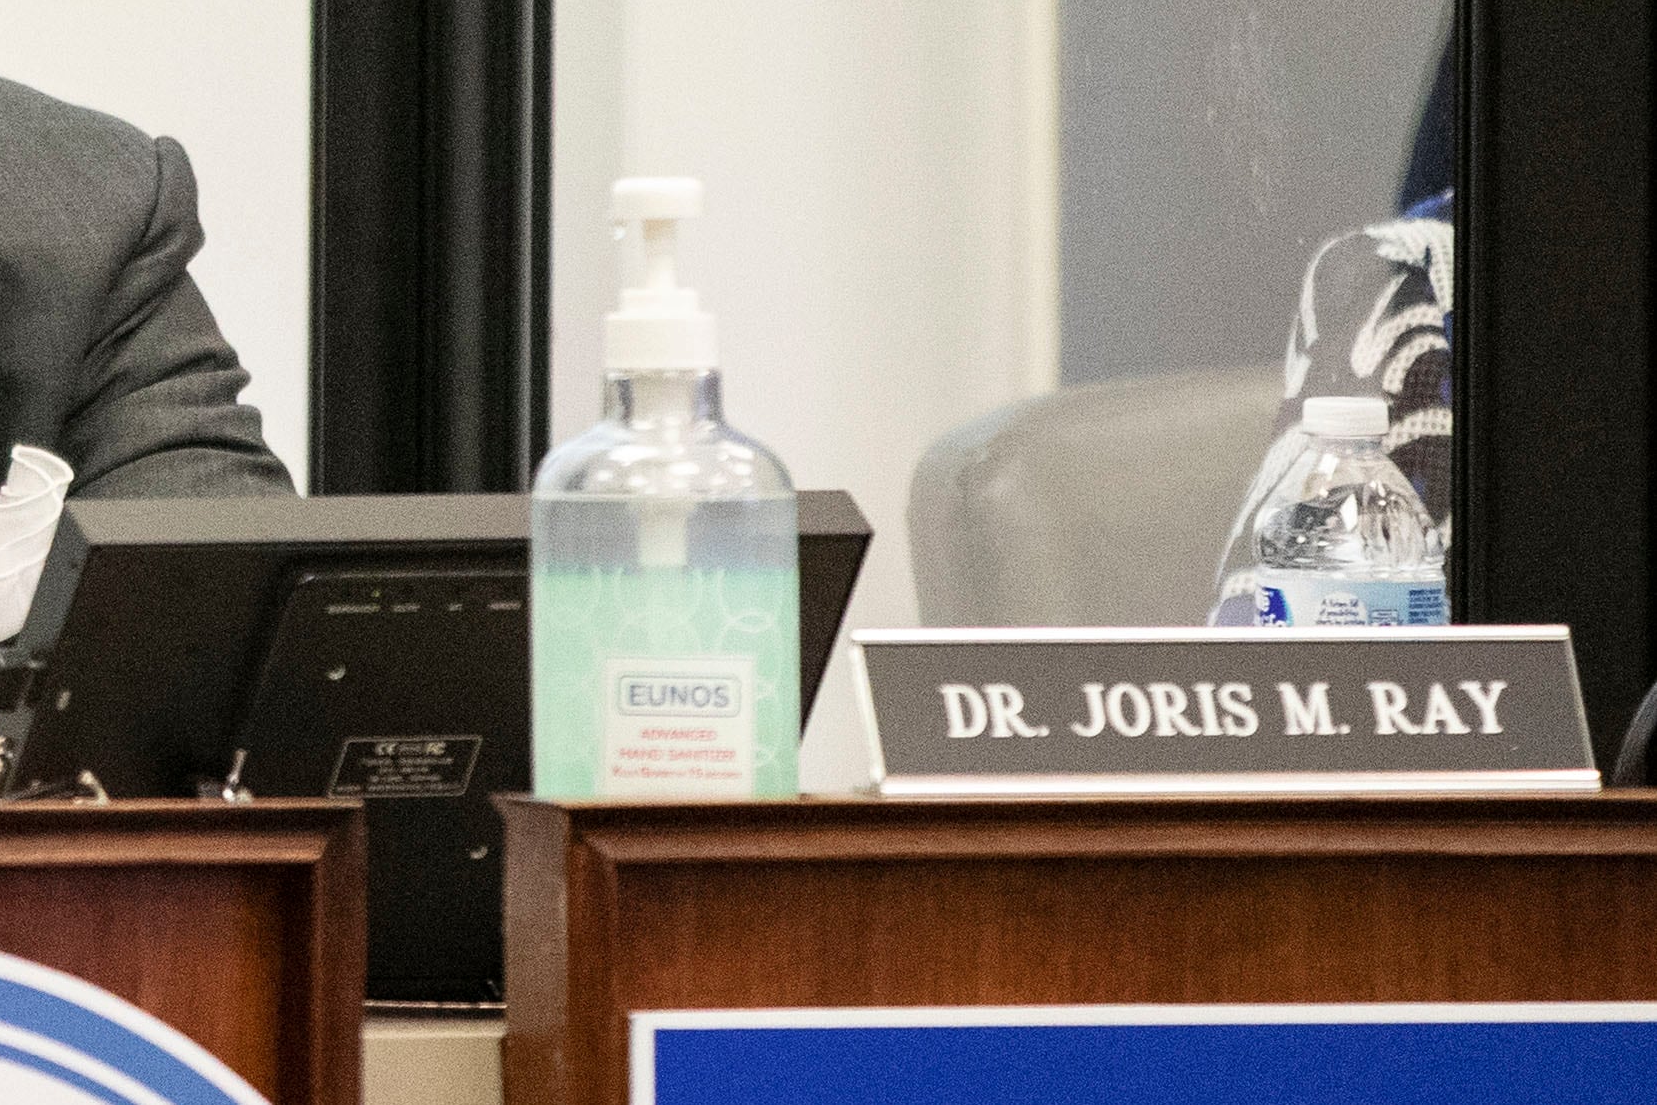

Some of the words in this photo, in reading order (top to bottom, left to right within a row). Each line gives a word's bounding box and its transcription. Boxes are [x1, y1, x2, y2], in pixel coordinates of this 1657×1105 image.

[628, 683, 731, 708] EUNOS
[939, 681, 1050, 738] DR.
[1071, 681, 1259, 737] JORIS
[1276, 680, 1351, 736] M.
[1366, 679, 1509, 735] RAY
